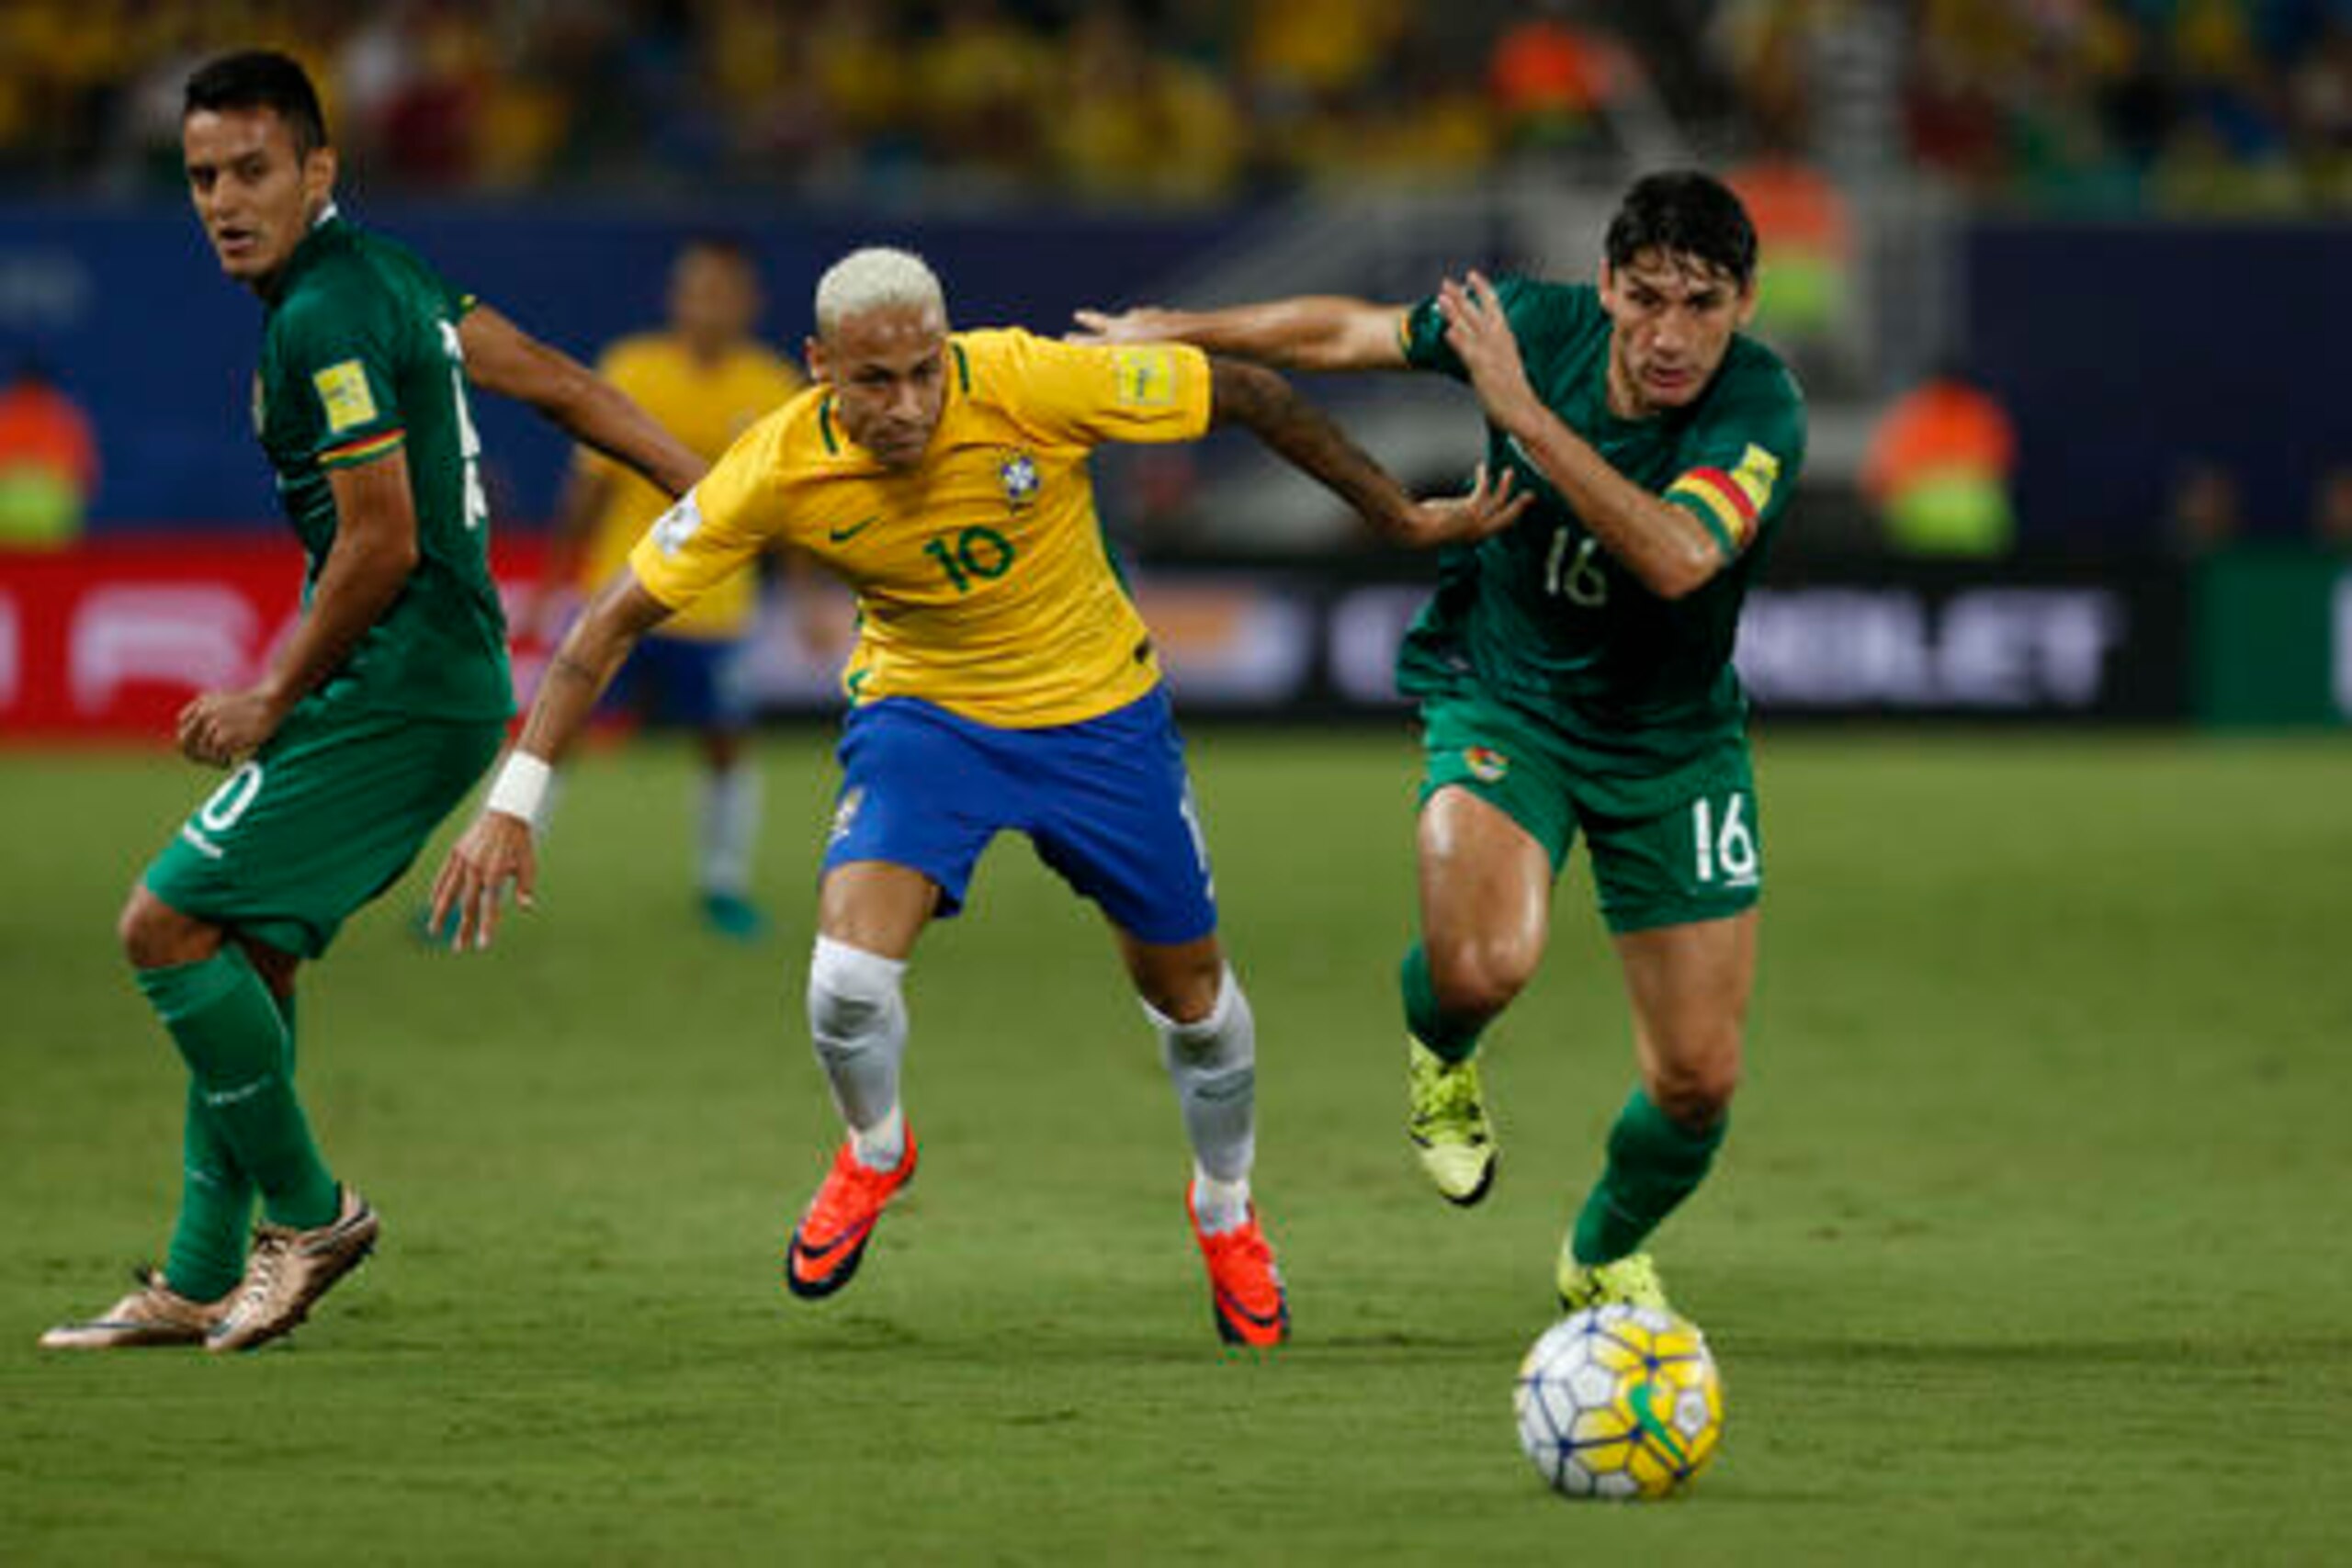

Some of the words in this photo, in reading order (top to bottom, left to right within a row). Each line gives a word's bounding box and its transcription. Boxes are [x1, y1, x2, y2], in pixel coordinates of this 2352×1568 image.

[922, 525, 1014, 592] 10
[1545, 526, 1607, 606] 16
[1692, 792, 1756, 882] 16
